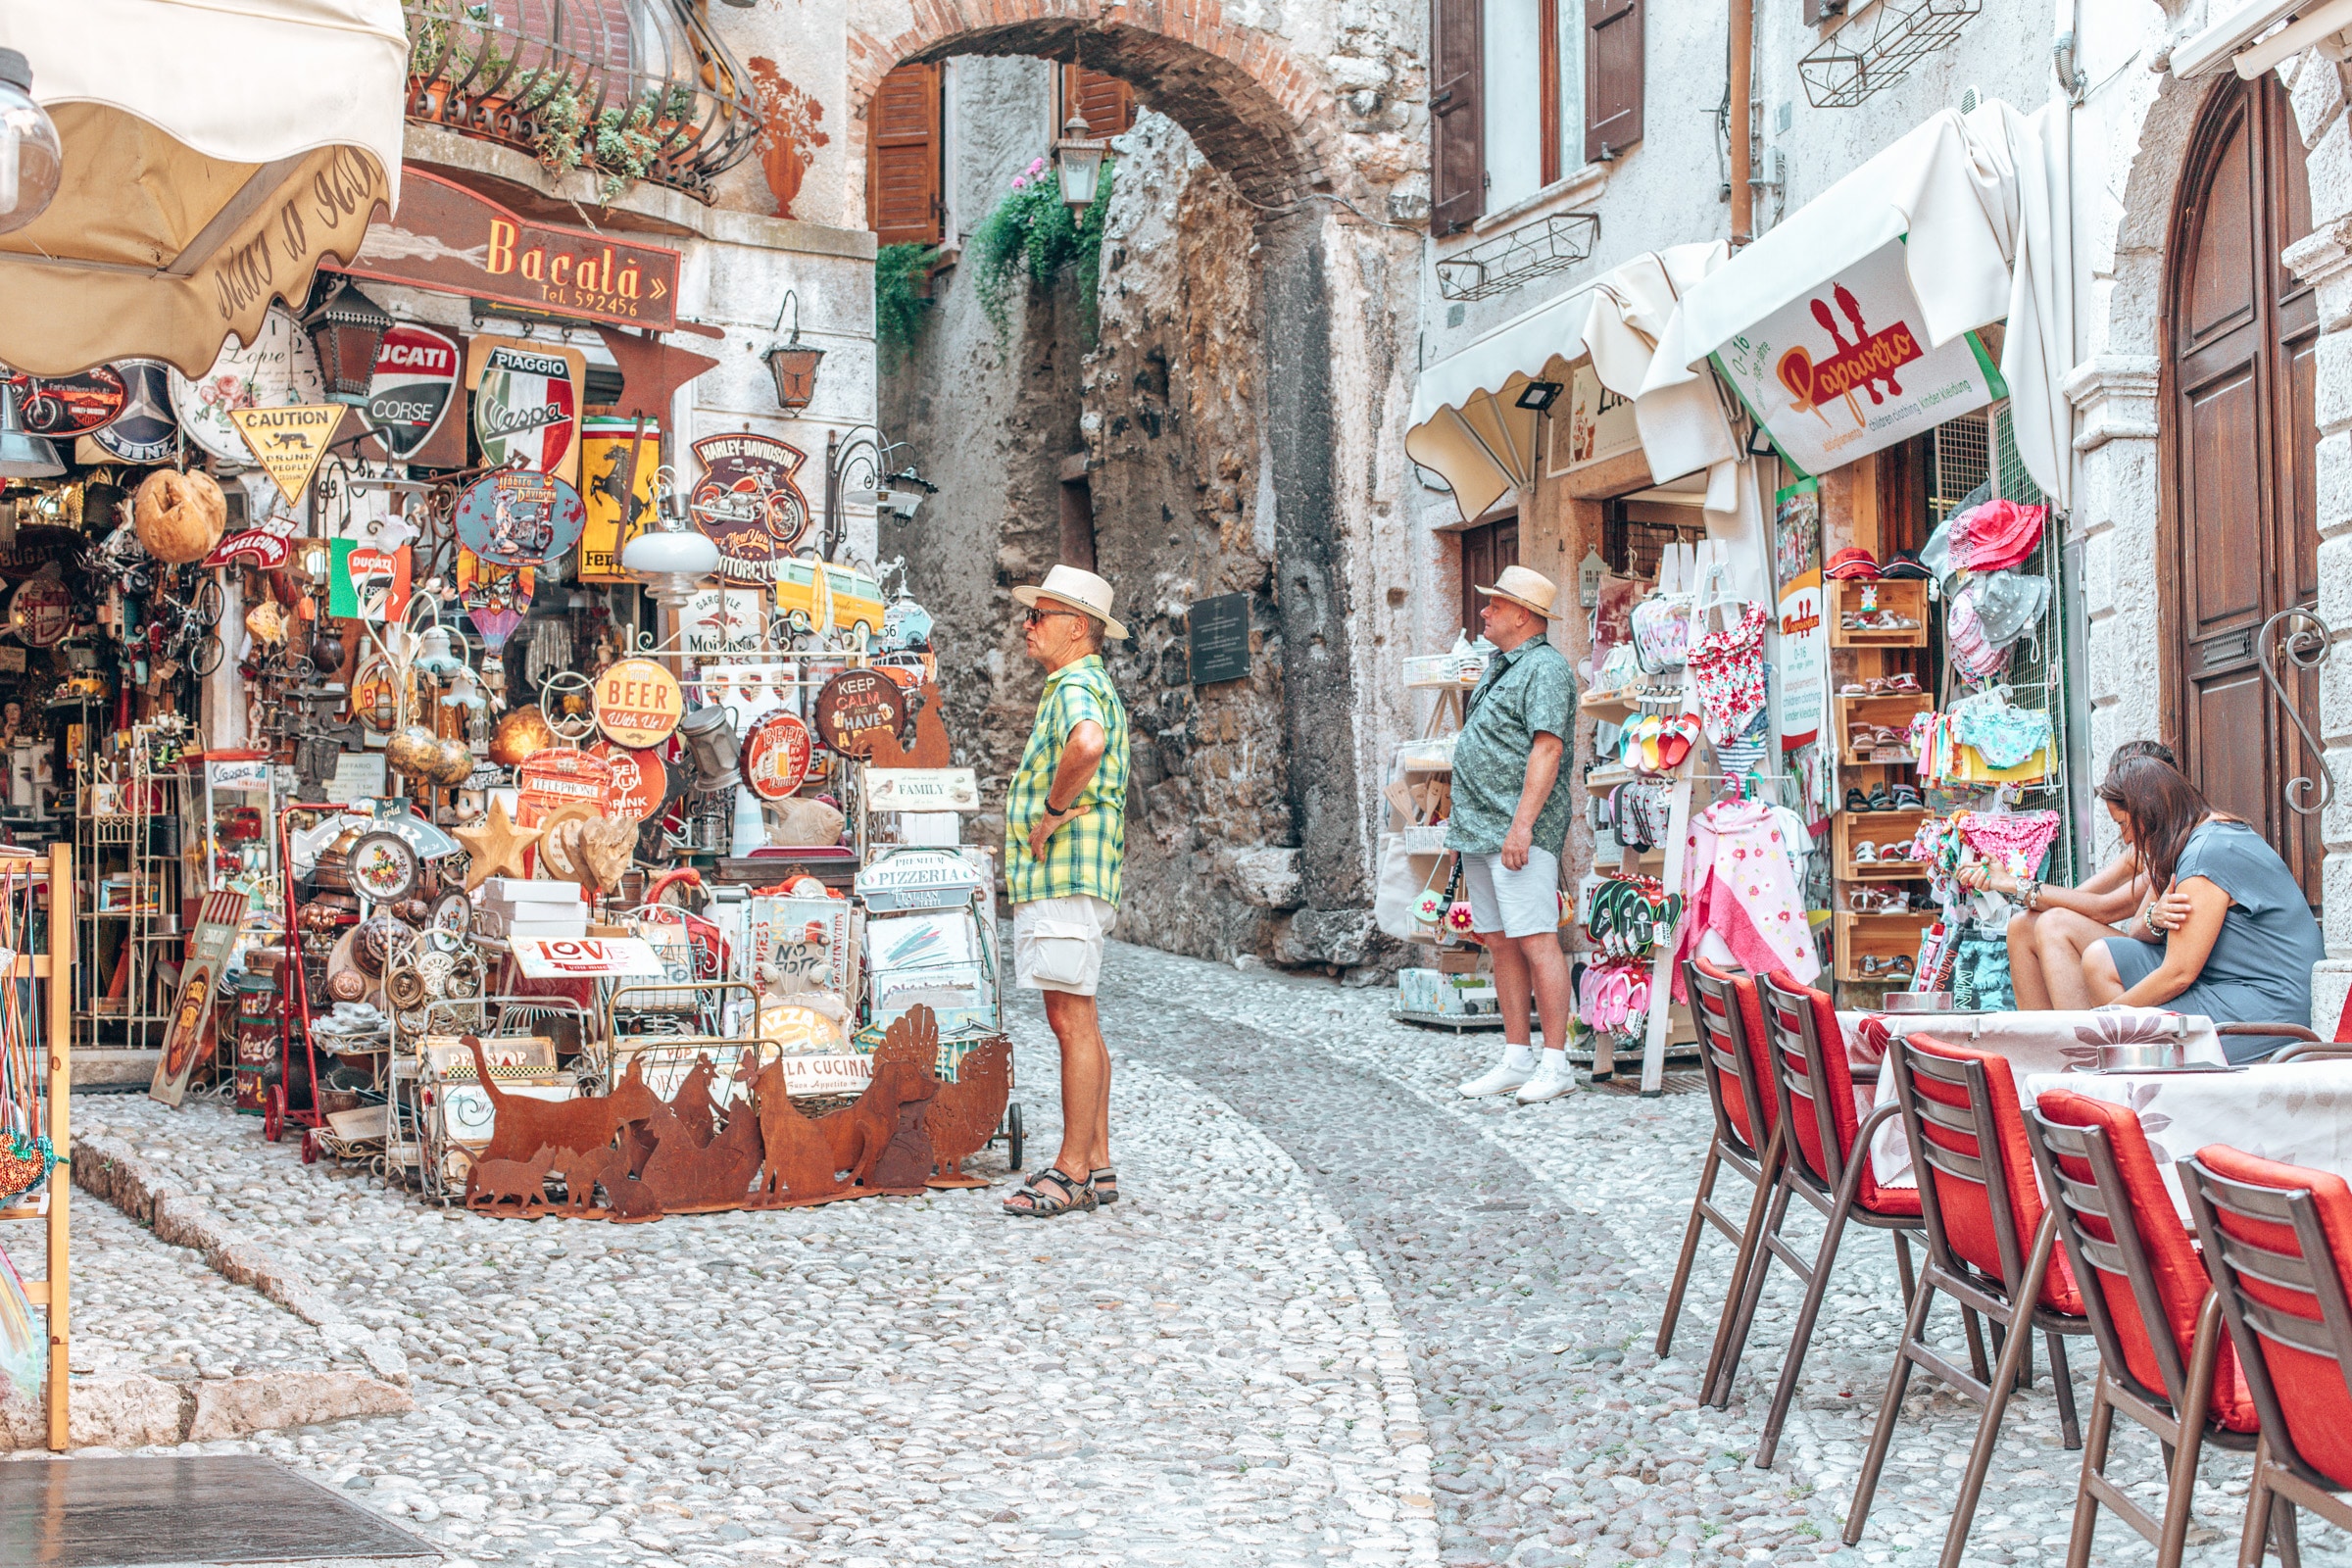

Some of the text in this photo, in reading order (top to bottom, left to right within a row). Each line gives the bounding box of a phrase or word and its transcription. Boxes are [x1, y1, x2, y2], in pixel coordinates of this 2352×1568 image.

[485, 216, 643, 301] Bacalà
[542, 284, 638, 318] Tel. 592456
[219, 343, 286, 365] Love
[377, 343, 448, 368] UCATI
[495, 352, 564, 376] PIAGGIO
[1776, 331, 1912, 428] Papavero
[371, 400, 433, 421] CORSE
[1869, 413, 1893, 432] children
[1892, 402, 1923, 422] clothing
[1917, 393, 1940, 410] kinder
[1939, 379, 1973, 403] kleidung
[246, 410, 328, 427] CAUTION
[484, 394, 572, 443] Vespa
[118, 444, 171, 461] BENZ
[266, 454, 315, 463] DRUNK
[700, 438, 798, 470] HARLEY-DAVIDSON
[272, 463, 309, 472] PEOPLE
[517, 489, 558, 503] DAVIDSON
[220, 534, 284, 564] WELCOME
[584, 551, 615, 567] Fer
[696, 594, 742, 611] GARGYLE
[1583, 589, 1598, 598] HO
[1780, 613, 1819, 639] Papavero
[1793, 647, 1807, 661] 0-16
[608, 680, 668, 710] BEER
[837, 677, 876, 695] KEEP
[836, 691, 881, 710] CALM
[608, 712, 638, 728] With
[854, 707, 868, 715] AND
[844, 712, 882, 731] HAVE
[763, 725, 806, 748] BEER
[533, 779, 599, 798] TELEPHONE
[899, 784, 945, 795] FAMILY
[382, 806, 402, 818] cold
[609, 797, 649, 809] RINK
[896, 857, 945, 867] PREMIUM
[879, 868, 958, 886] PIZZERIA
[894, 891, 938, 902] ITALIAN
[536, 941, 630, 959] LOVE
[775, 944, 807, 961] NO
[813, 1058, 870, 1078] CUCINA
[810, 1079, 849, 1090] Appetito
